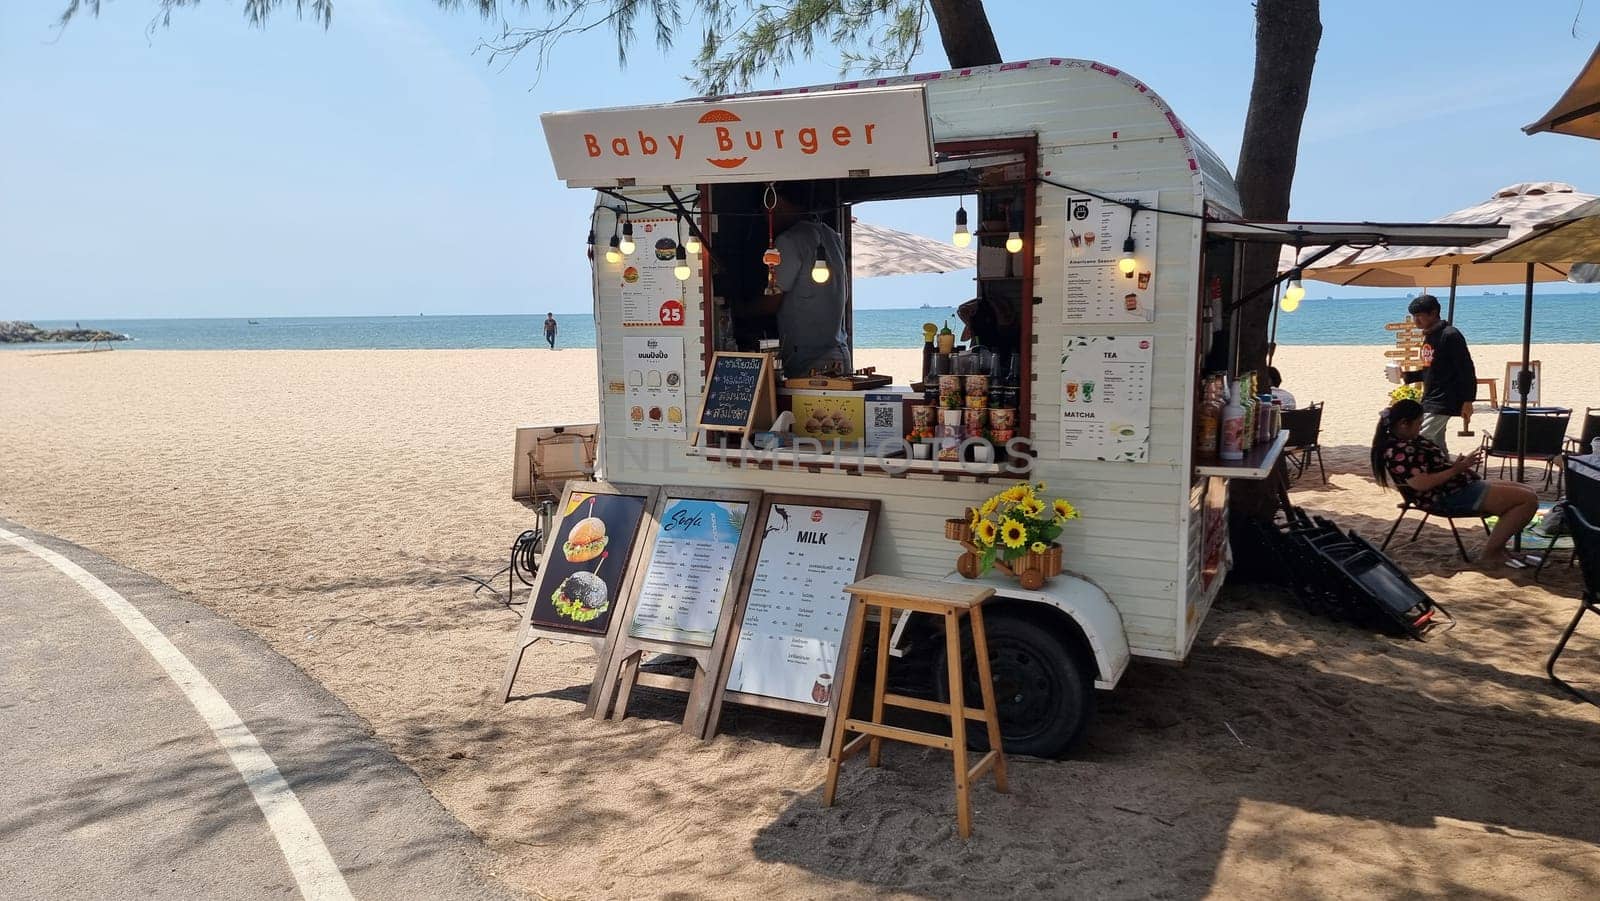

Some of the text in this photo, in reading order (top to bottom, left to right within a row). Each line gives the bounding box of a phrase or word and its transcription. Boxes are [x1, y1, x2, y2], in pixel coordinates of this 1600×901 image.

[584, 122, 876, 160] Baby Burger
[662, 308, 681, 322] 25
[664, 509, 702, 532] Soda
[796, 530, 829, 545] MILK
